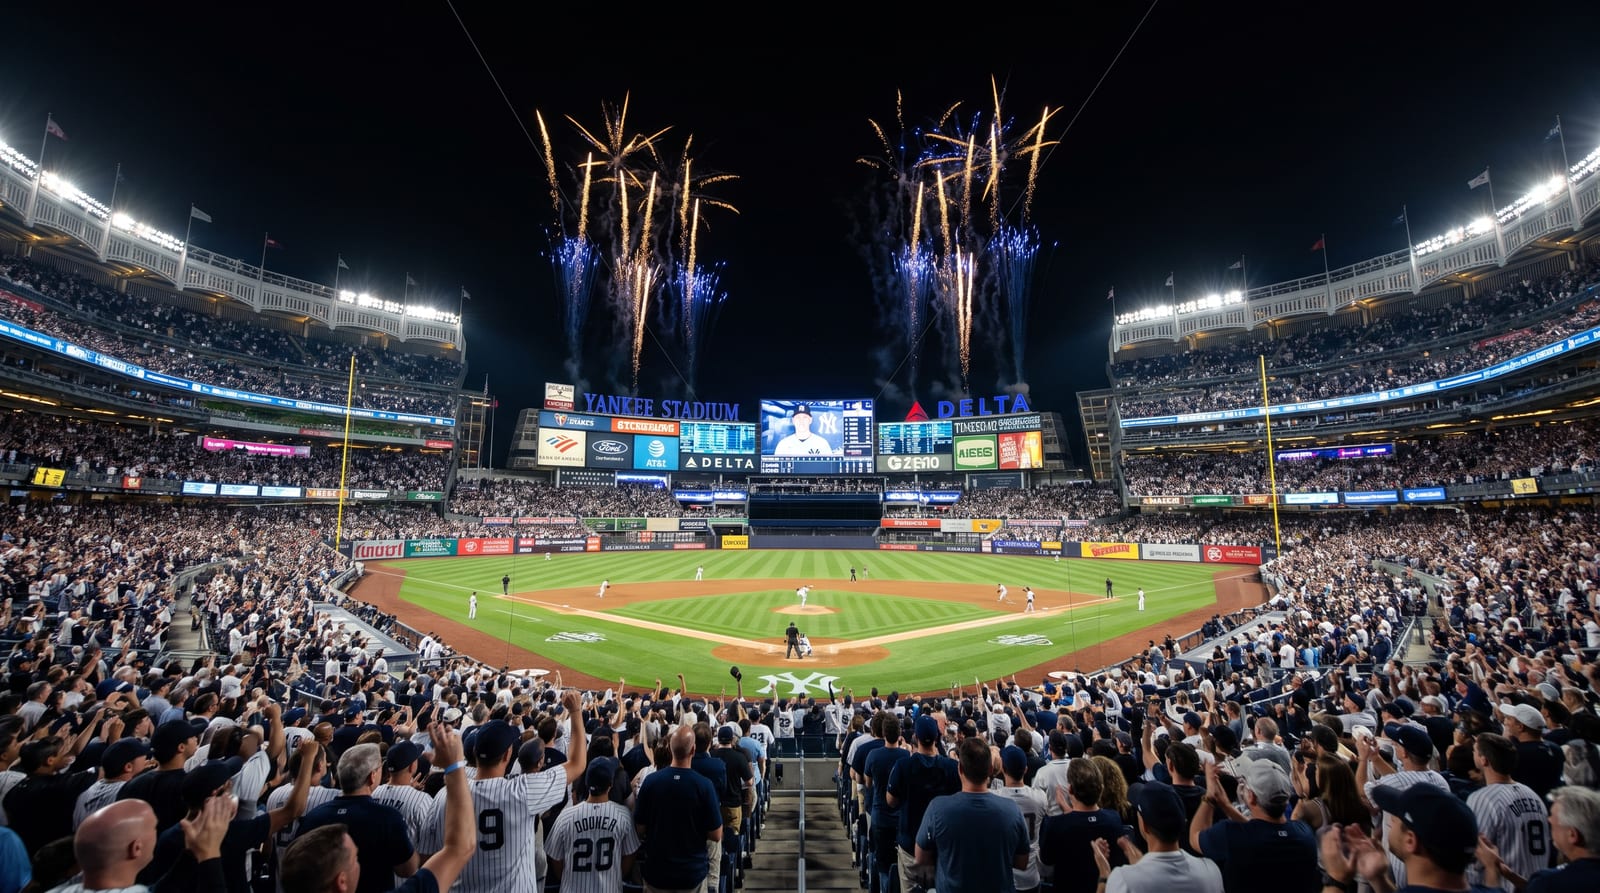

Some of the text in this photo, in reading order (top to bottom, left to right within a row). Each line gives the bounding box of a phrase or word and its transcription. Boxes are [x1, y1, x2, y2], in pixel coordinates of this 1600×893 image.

[584, 393, 740, 421] YANKEE STADIUM
[937, 393, 1030, 419] DELTA
[598, 441, 622, 452] Ford
[702, 457, 754, 469] DELTA
[479, 808, 504, 851] 9
